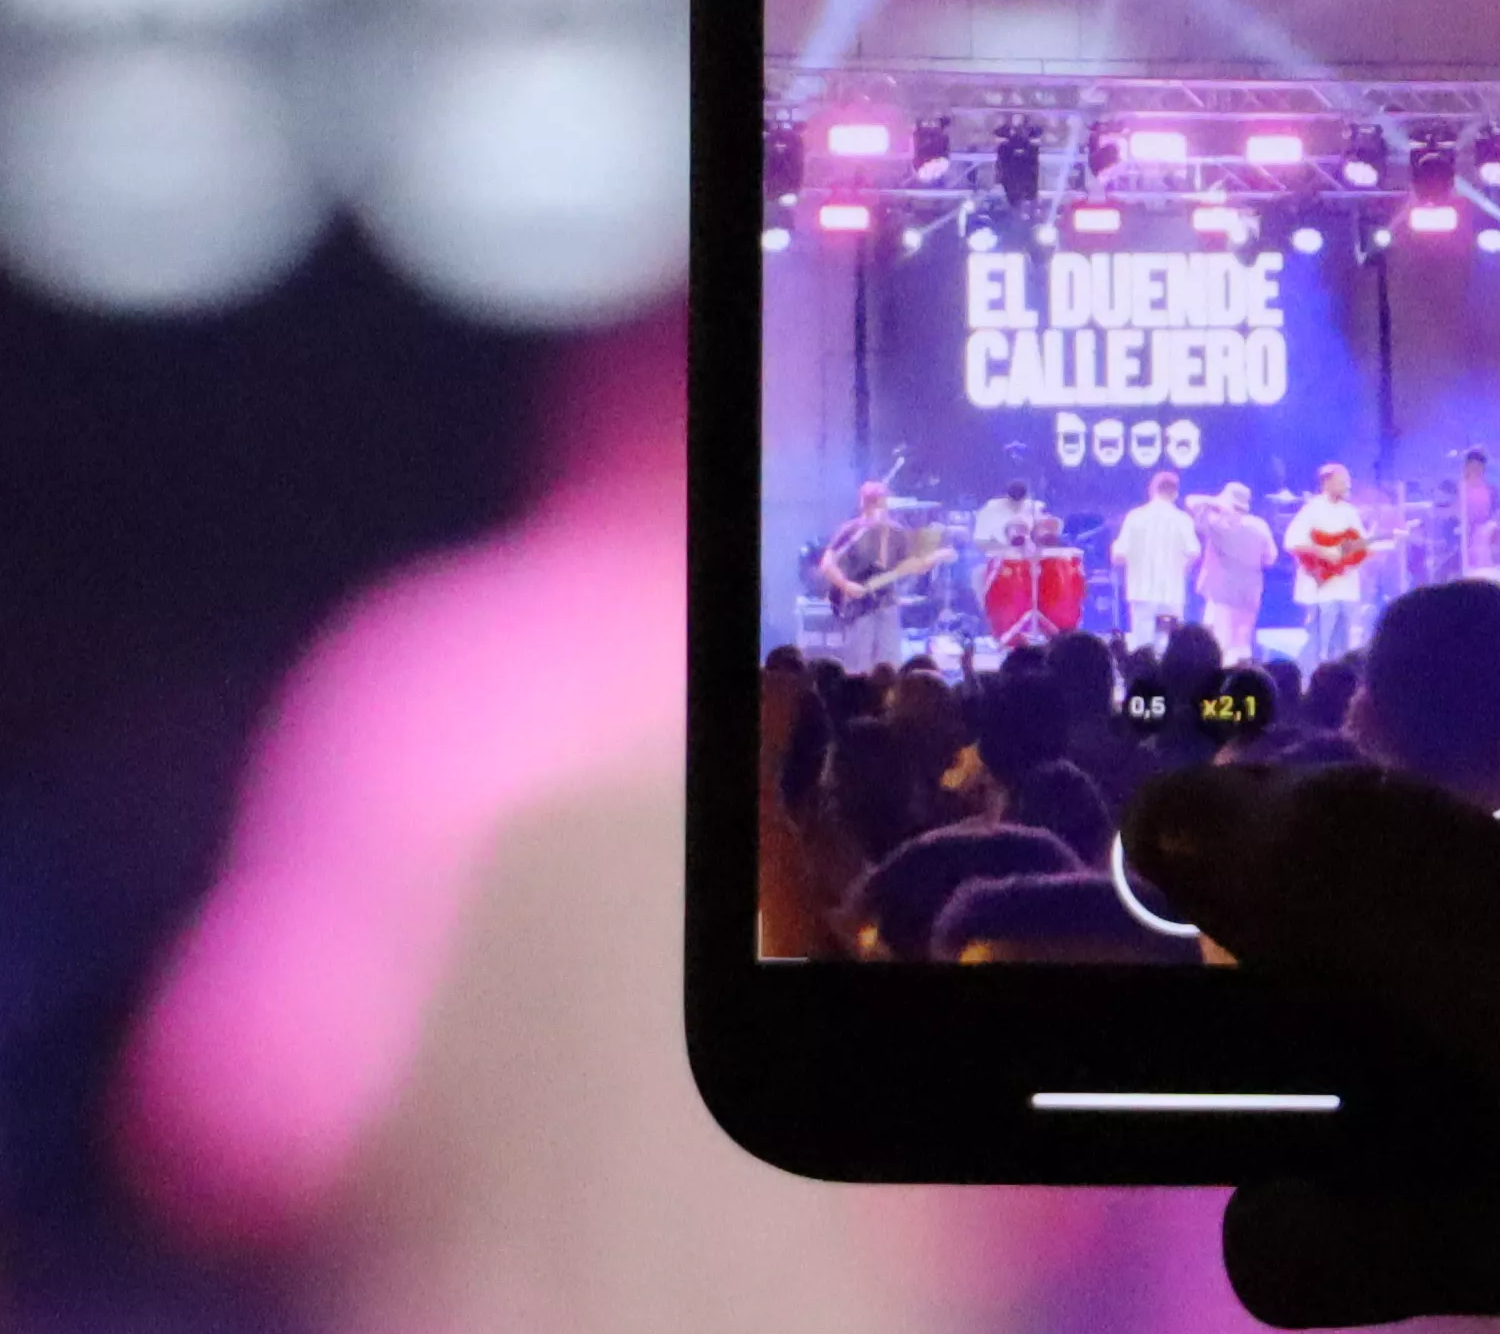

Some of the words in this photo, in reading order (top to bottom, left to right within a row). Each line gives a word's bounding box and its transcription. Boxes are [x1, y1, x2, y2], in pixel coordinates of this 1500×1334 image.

[967, 251, 1039, 329] EL
[1049, 251, 1285, 328] DUENDE
[965, 328, 1288, 407] CALLEJERO
[1128, 695, 1167, 720] 0,5
[1202, 695, 1257, 722] x2,1
